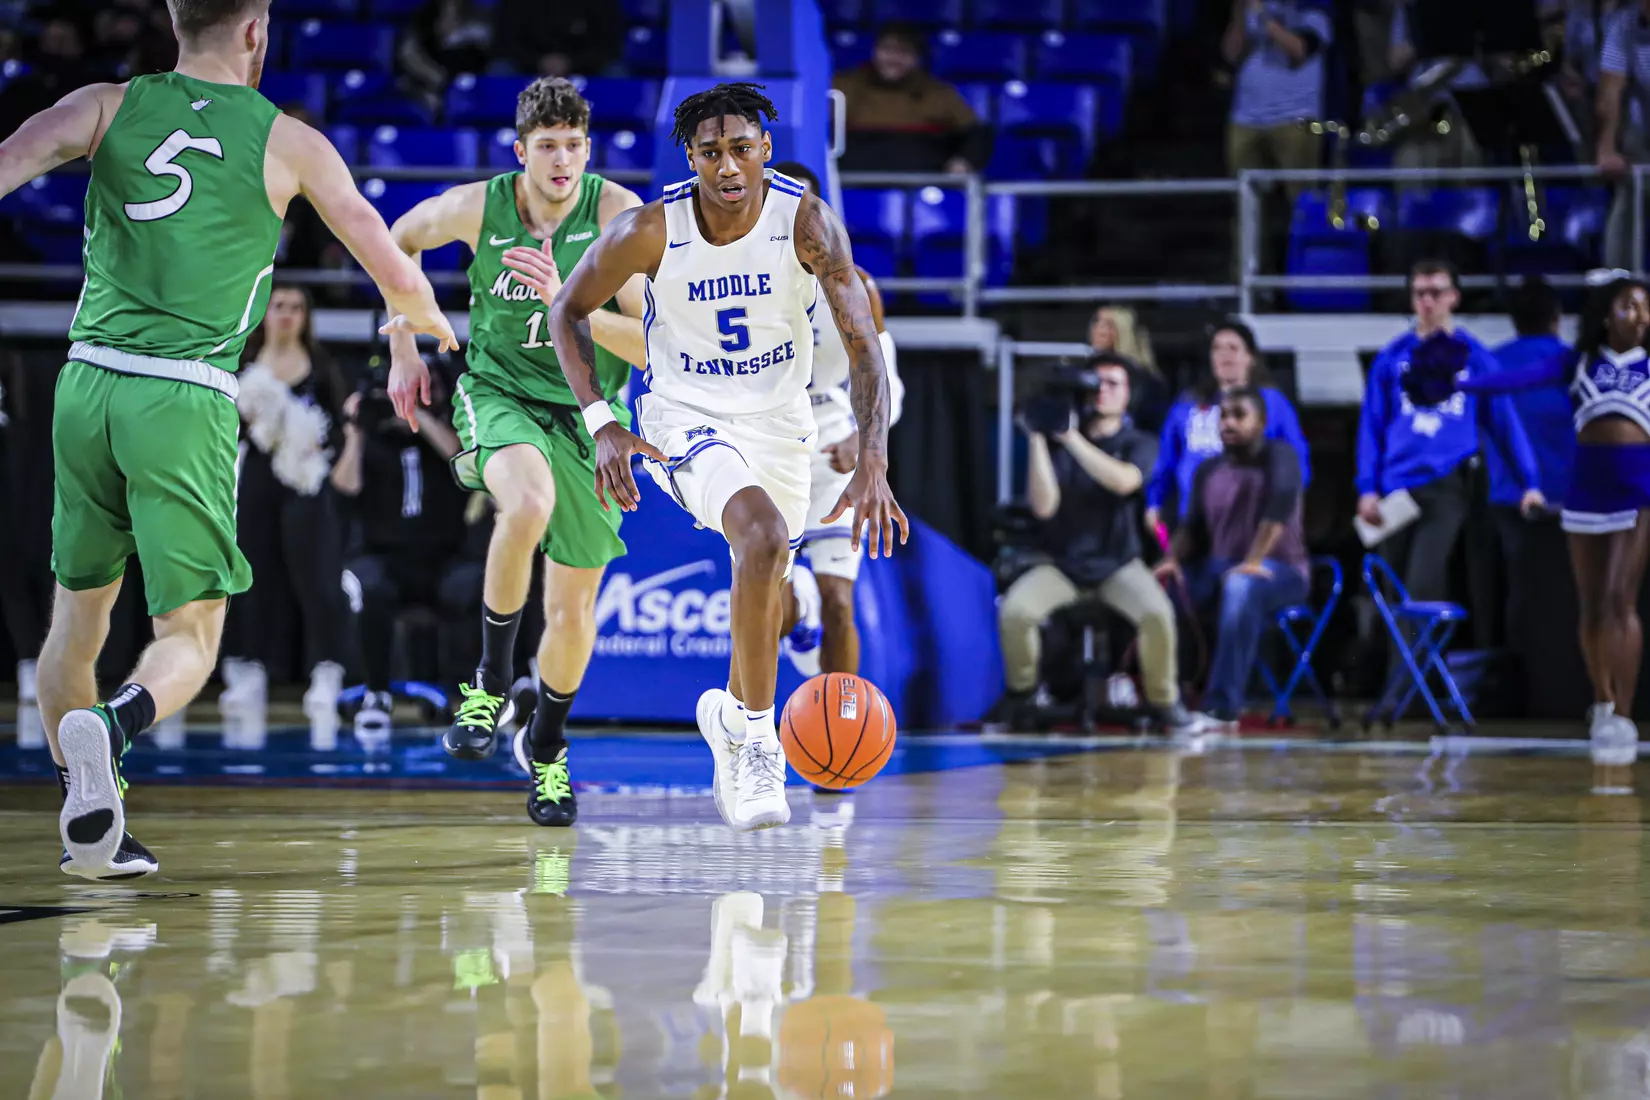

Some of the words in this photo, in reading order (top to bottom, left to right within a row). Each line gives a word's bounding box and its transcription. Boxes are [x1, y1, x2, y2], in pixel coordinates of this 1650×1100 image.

[123, 127, 225, 222] 5
[489, 269, 542, 301] Mar
[687, 272, 772, 302] MIDDLE
[520, 310, 554, 349] 1
[714, 305, 752, 355] 5
[680, 340, 796, 377] TENNESSEE
[594, 561, 731, 634] Asce
[593, 632, 668, 657] ederal
[840, 676, 858, 721] ELITE
